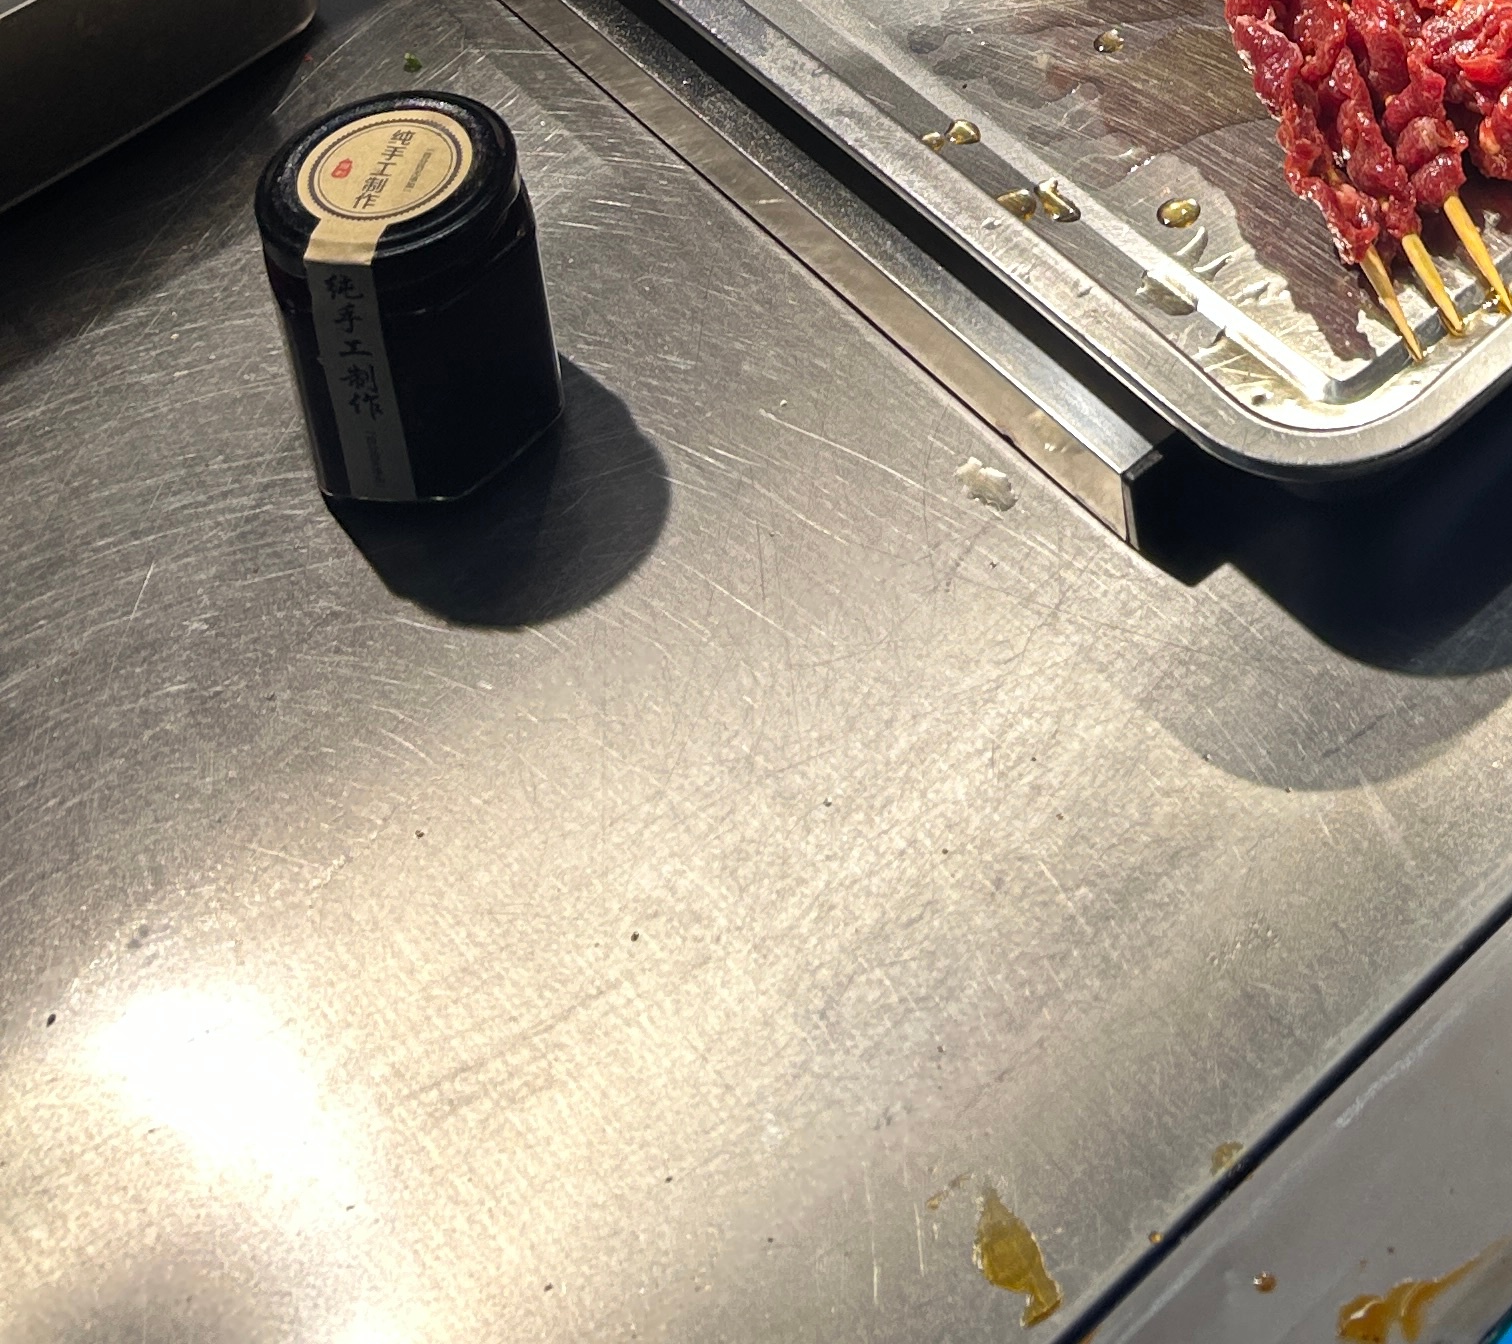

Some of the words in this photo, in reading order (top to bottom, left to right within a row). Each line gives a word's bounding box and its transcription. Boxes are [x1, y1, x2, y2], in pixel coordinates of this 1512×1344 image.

[352, 128, 414, 210] 纯手工制作
[324, 273, 383, 421] 纯手工制作
